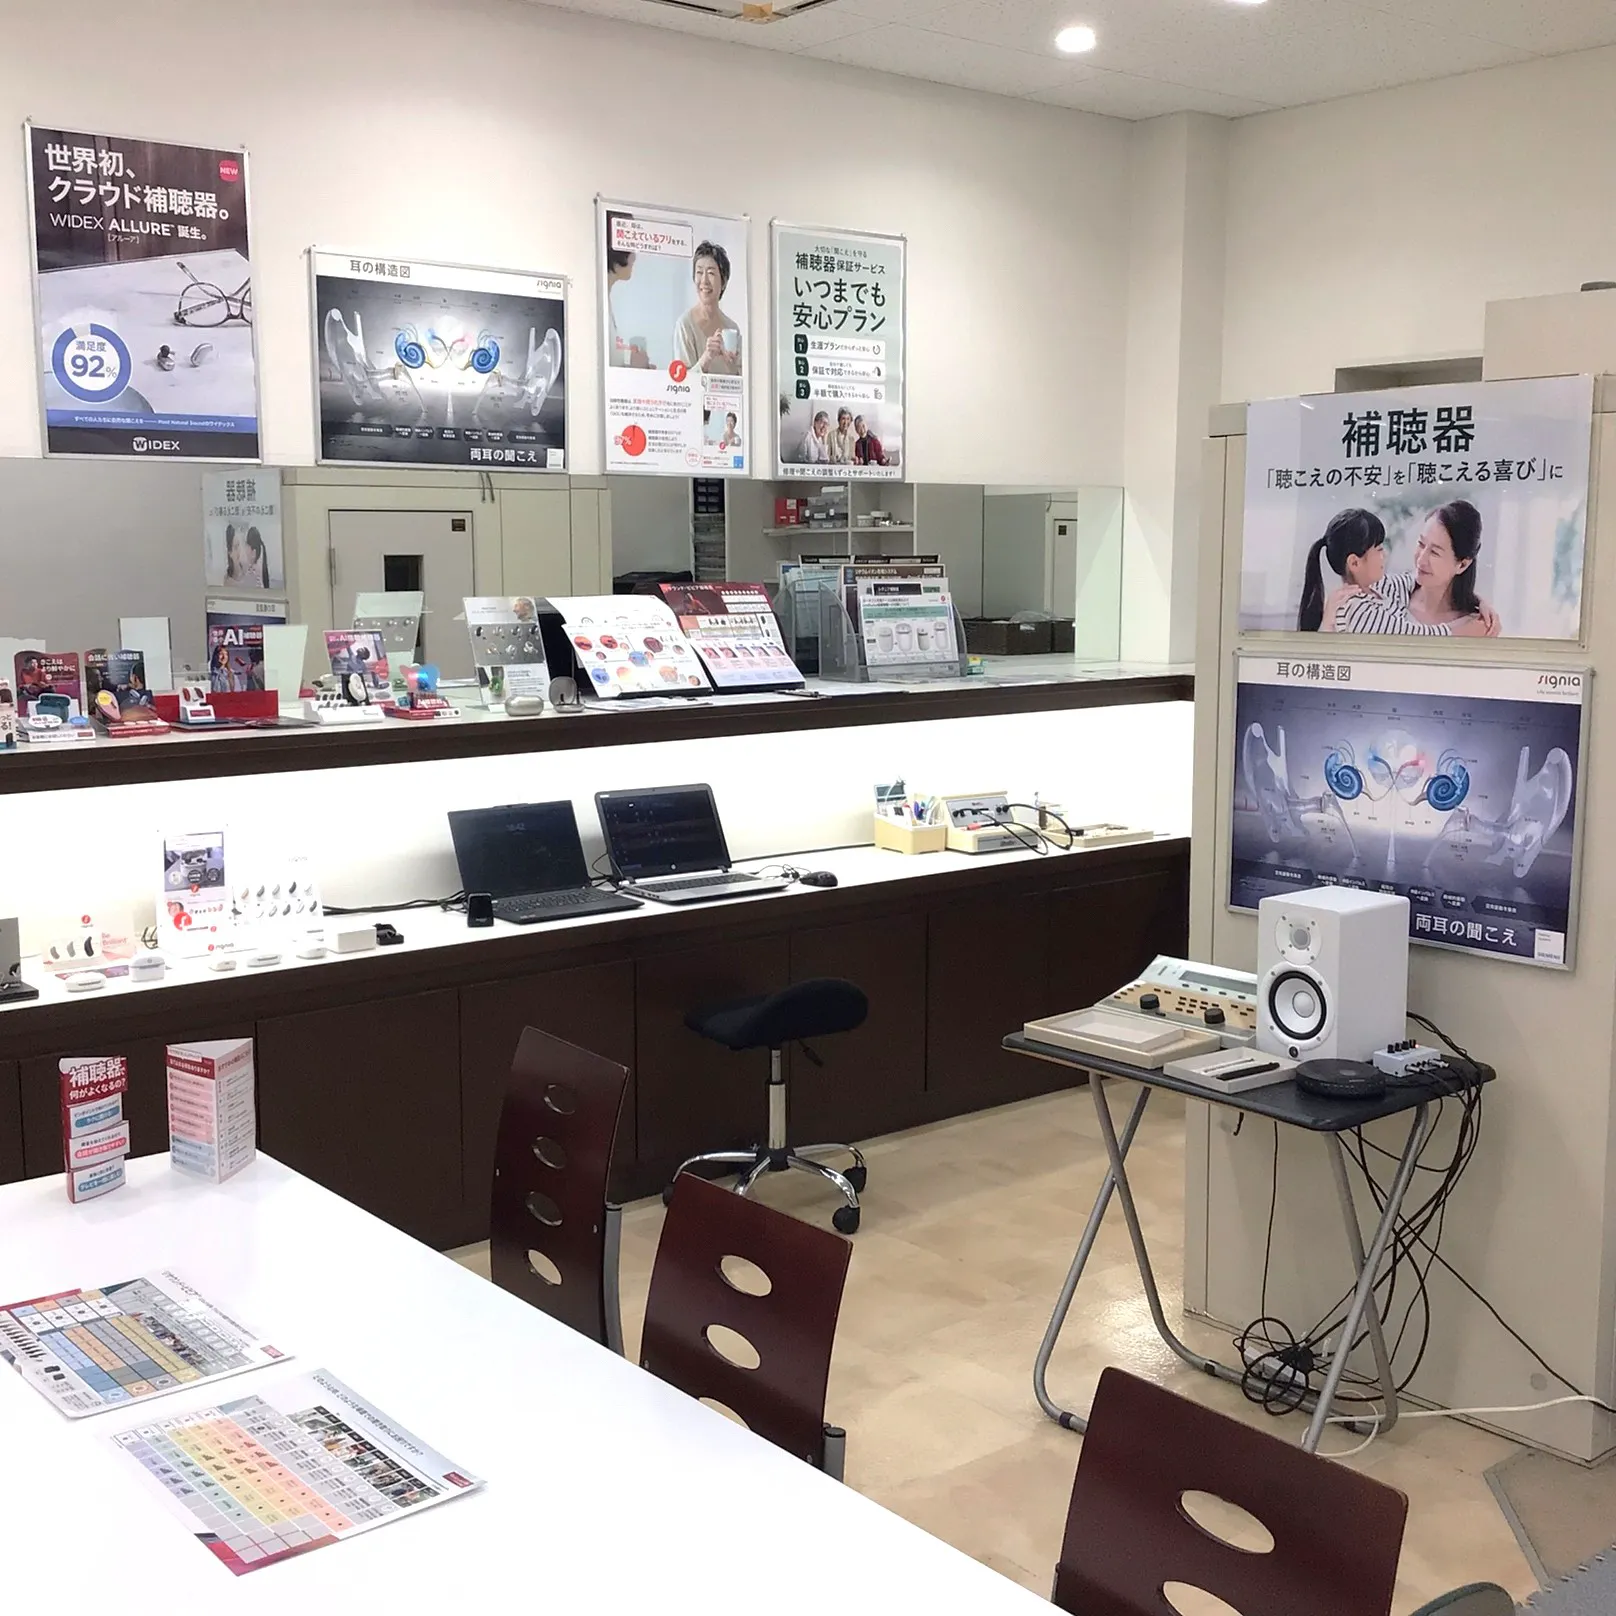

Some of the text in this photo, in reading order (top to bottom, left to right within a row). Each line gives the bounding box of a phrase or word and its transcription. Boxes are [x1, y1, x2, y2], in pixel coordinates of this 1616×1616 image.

[45, 143, 136, 179] 世界初、
[220, 166, 239, 176] NEW
[48, 176, 230, 221] クラウド補聴器。
[50, 213, 104, 231] WIDEX
[177, 225, 207, 241] 誕生。
[349, 259, 411, 279] 耳の構造図
[536, 279, 562, 290] signia
[794, 275, 886, 307] いつまでも
[792, 301, 887, 333] 安心プラン
[75, 340, 107, 354] 満足度
[70, 355, 118, 380] 92%
[666, 384, 691, 395] signia
[1341, 404, 1476, 459] 補聴器
[132, 436, 181, 452] WIDEX
[469, 447, 538, 463] 両耳の聞こえ
[1265, 457, 1564, 490] 「聴こえの不安」を「聴こえる喜び」に
[1276, 661, 1352, 682] 耳の構造図
[1537, 675, 1581, 689] signia
[1415, 912, 1518, 947] 両耳の聞こえ
